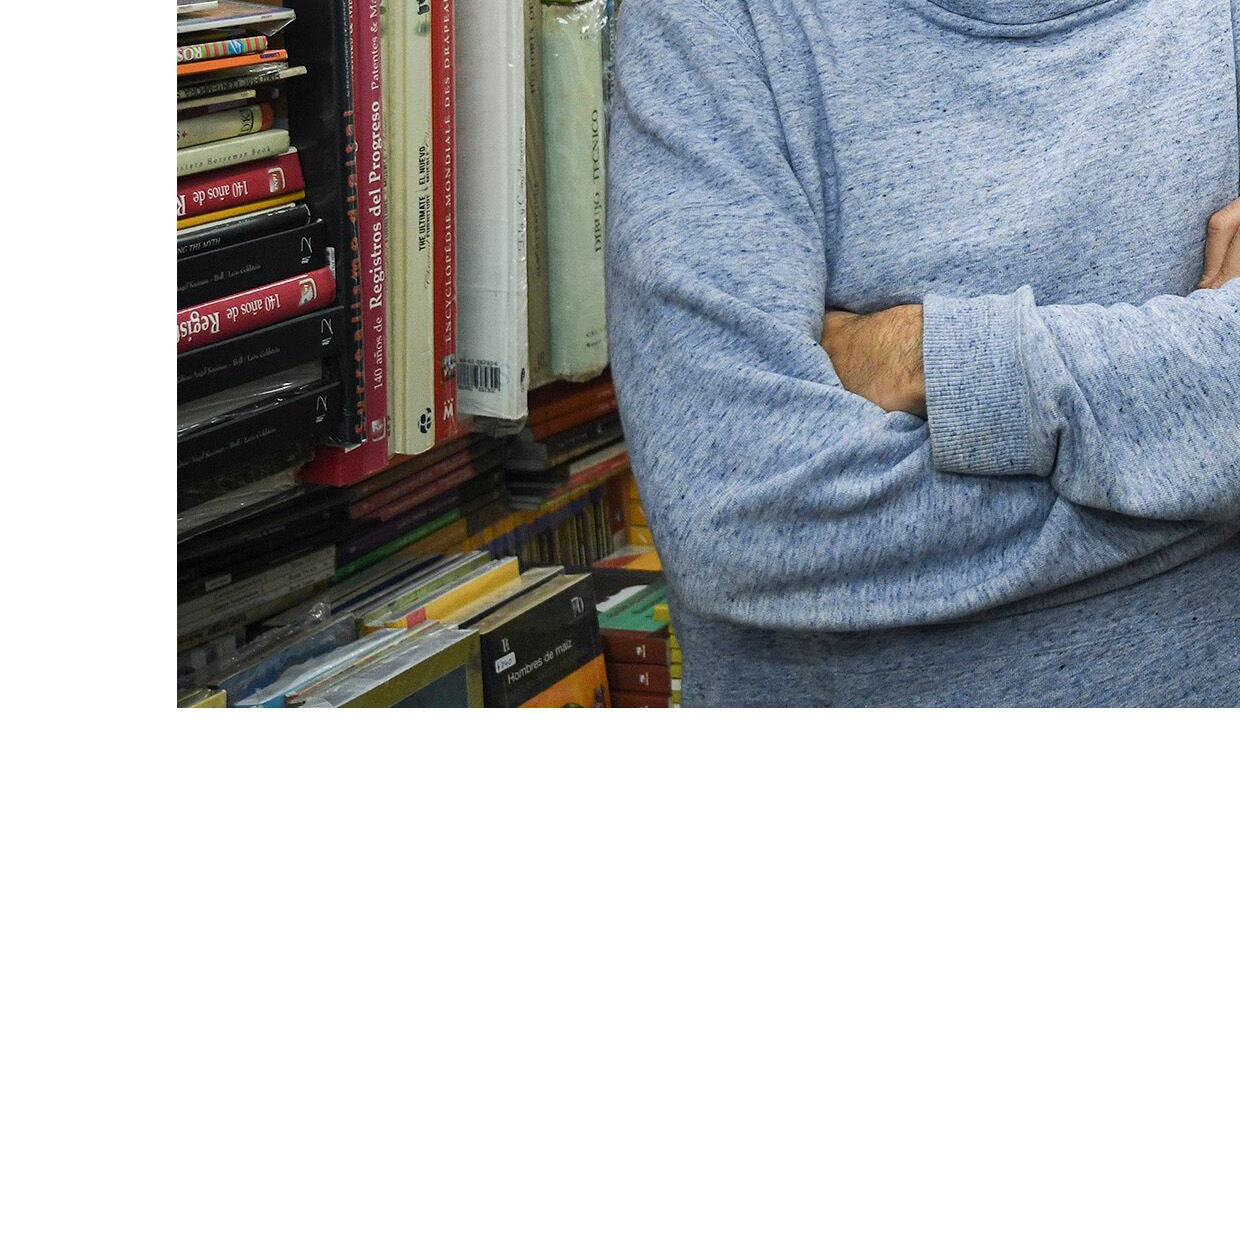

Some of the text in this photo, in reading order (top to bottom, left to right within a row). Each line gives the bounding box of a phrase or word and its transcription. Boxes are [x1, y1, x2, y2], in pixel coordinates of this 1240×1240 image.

[370, 22, 378, 33] &
[370, 35, 380, 90] Patentes
[529, 27, 537, 94] HISTORIA
[443, 77, 451, 107] DES
[368, 100, 382, 184] Progreso
[443, 115, 452, 206] MONDIALE
[208, 184, 232, 202] años
[233, 181, 249, 198] 140
[419, 175, 426, 185] EL
[193, 190, 207, 205] de
[368, 189, 382, 217] del
[418, 196, 426, 234] ULTIMATE
[594, 192, 603, 252] DIBUJO
[190, 240, 202, 254] THE
[204, 237, 221, 250] MYTH
[369, 222, 385, 310] Registros
[444, 212, 452, 343] ENCYCLOPÉDIE
[227, 305, 239, 320] de
[240, 299, 264, 317] años
[264, 293, 281, 310] 140
[373, 317, 383, 335] de
[373, 337, 383, 366] años
[374, 368, 383, 390] 140
[507, 657, 542, 684] Hombres
[544, 648, 554, 663] de
